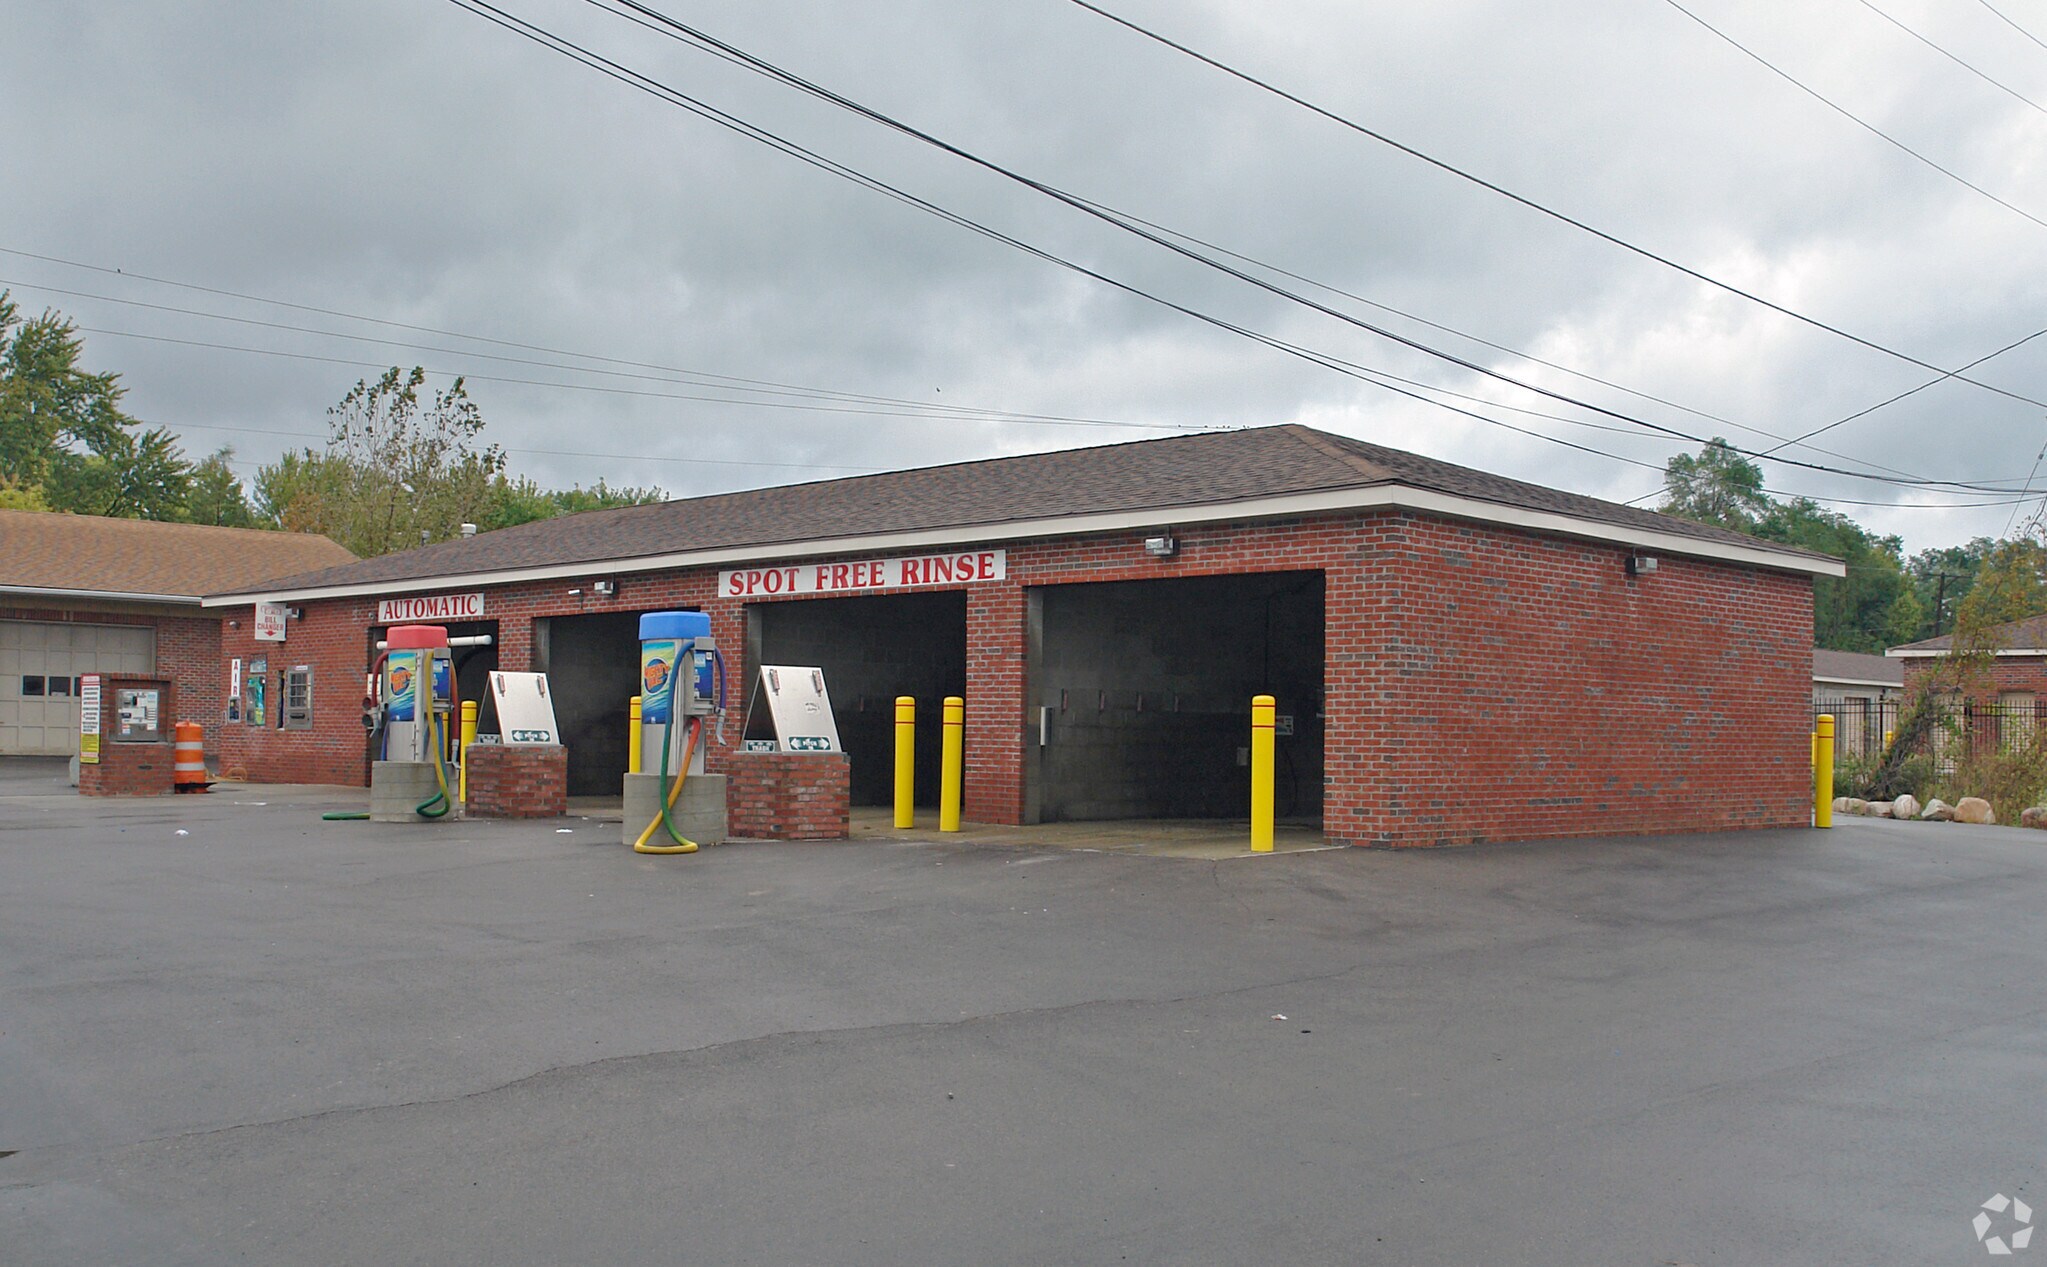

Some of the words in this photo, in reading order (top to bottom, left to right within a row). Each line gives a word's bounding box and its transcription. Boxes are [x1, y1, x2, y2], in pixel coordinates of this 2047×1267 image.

[729, 568, 799, 596] SPOT
[815, 561, 885, 590] FREE
[900, 553, 995, 585] RINSE
[384, 595, 478, 620] AUTOMATIC
[257, 623, 284, 631] CHANGER
